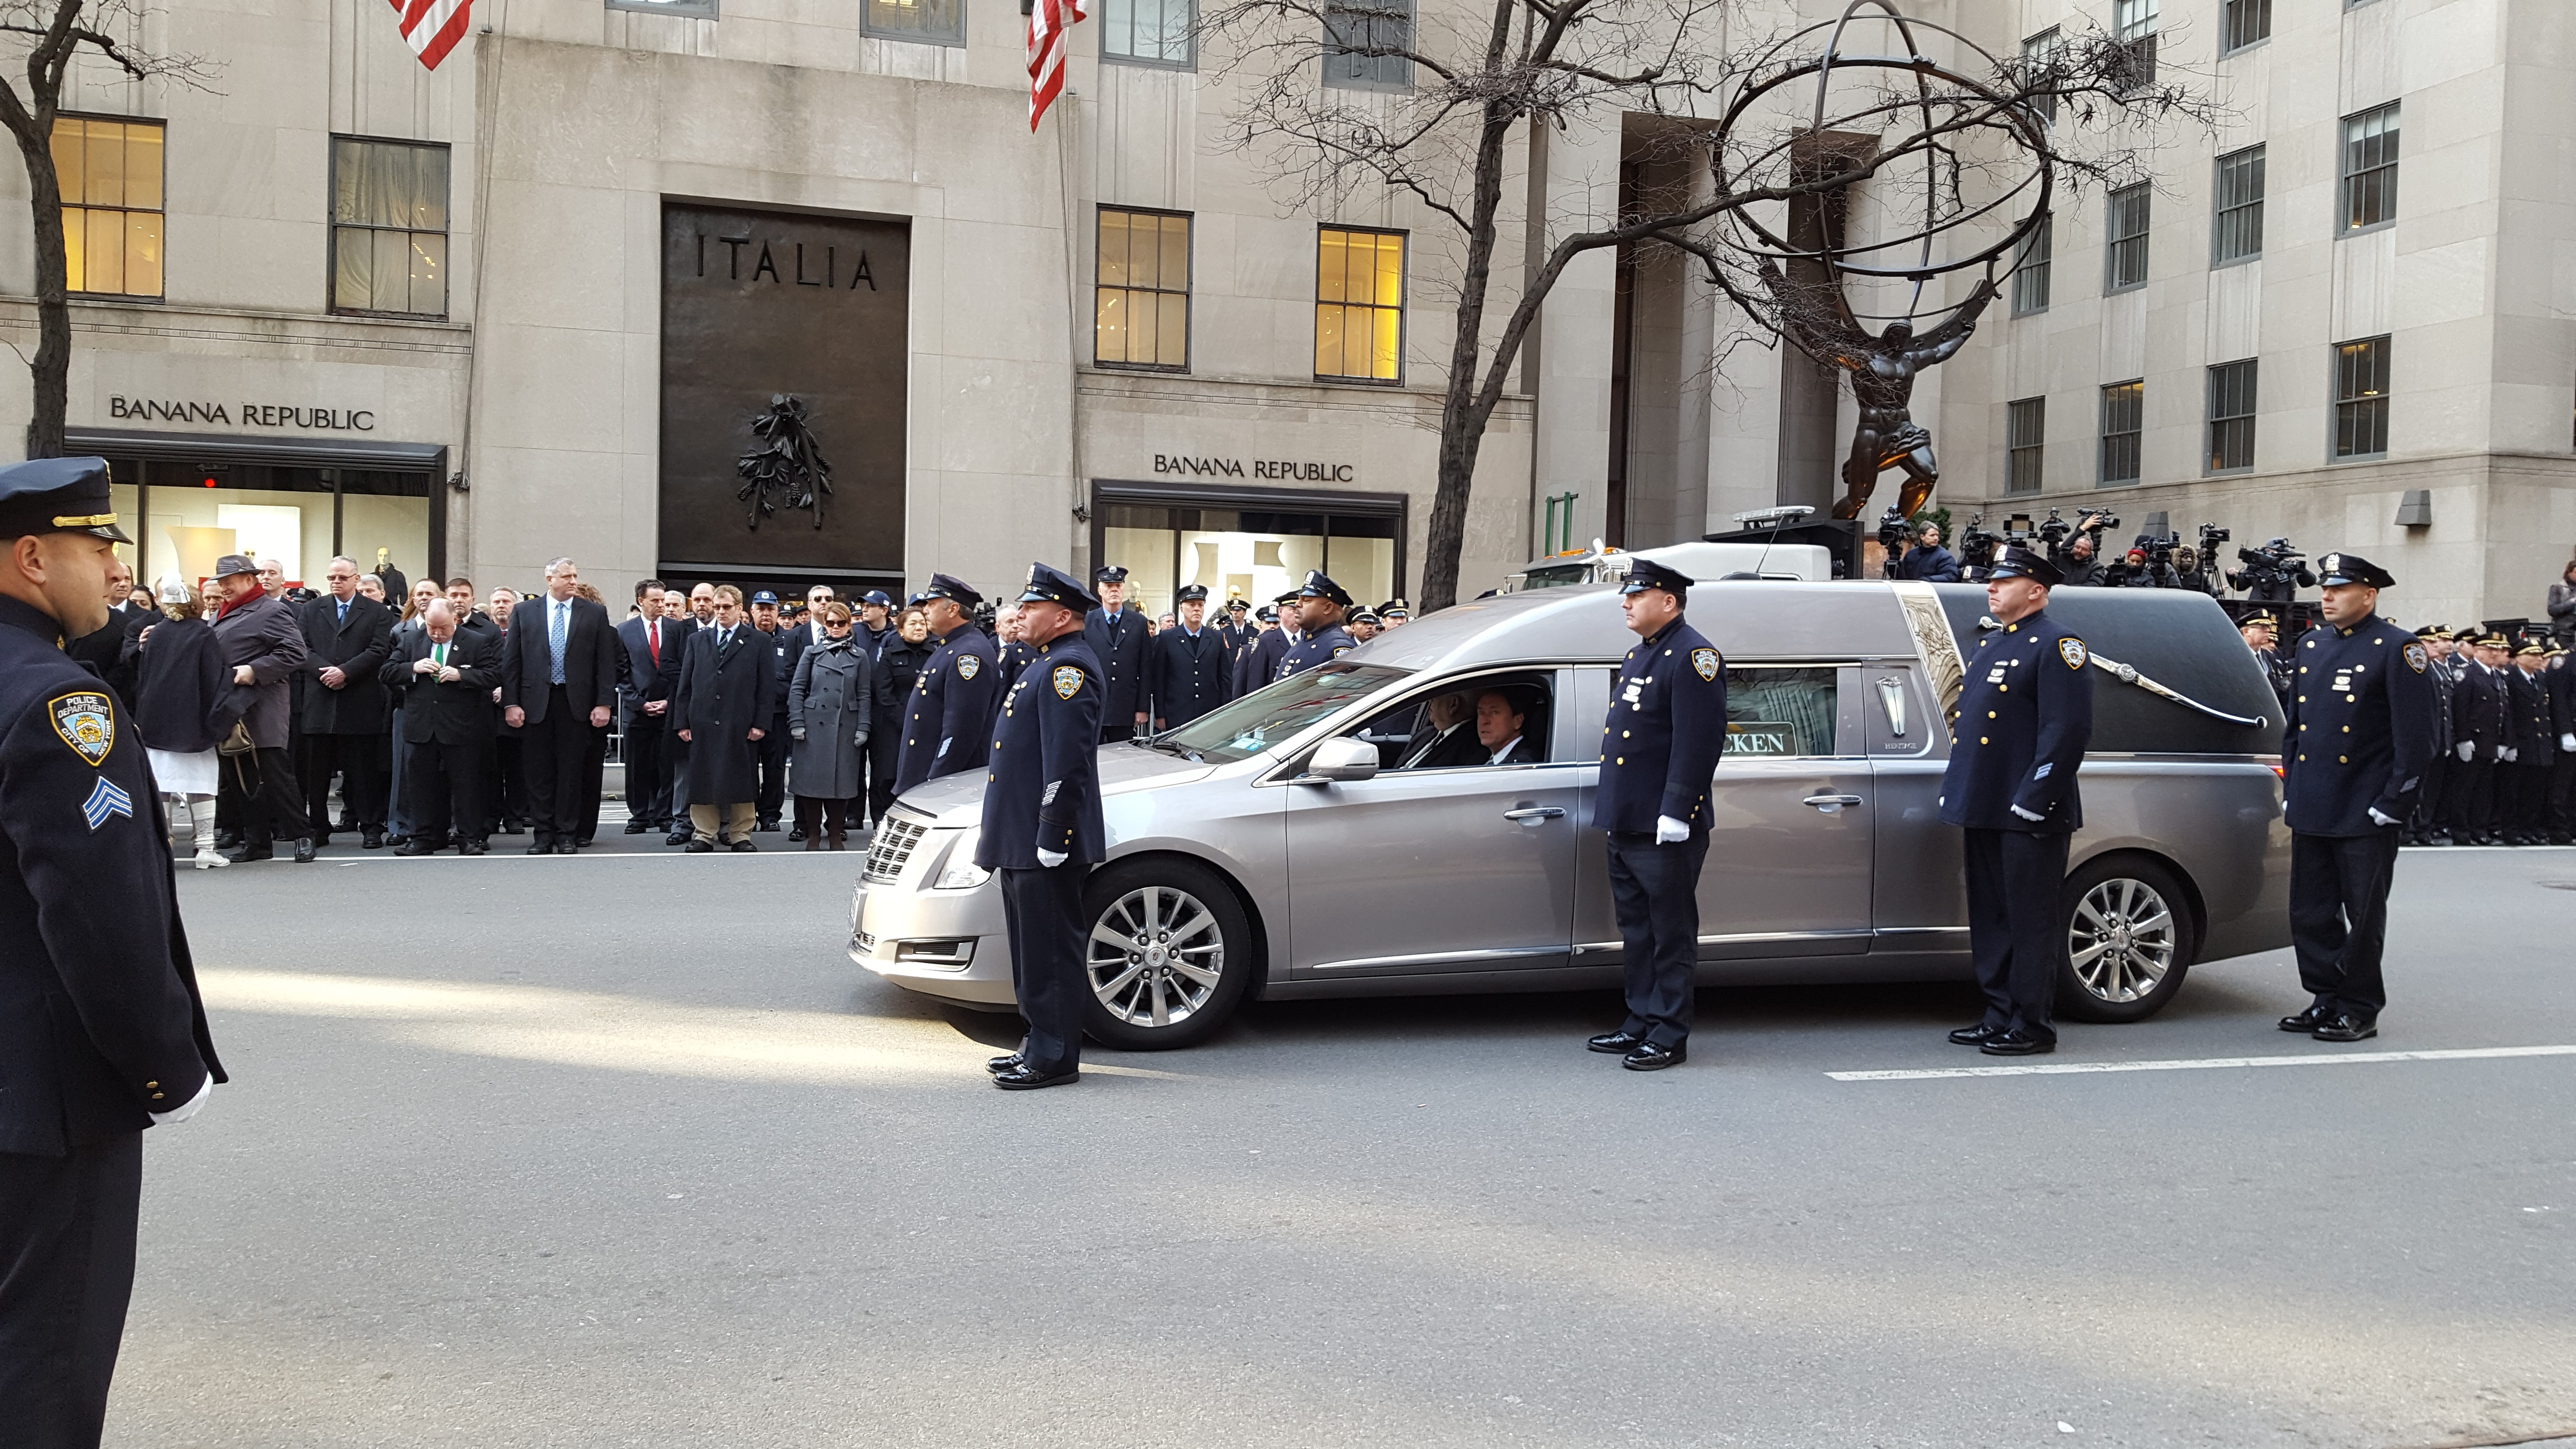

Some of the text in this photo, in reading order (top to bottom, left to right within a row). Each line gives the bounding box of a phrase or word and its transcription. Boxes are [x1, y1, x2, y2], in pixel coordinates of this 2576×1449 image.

[697, 234, 877, 291] ITALIA
[110, 397, 374, 431] BANANA REPUBLIC
[1154, 454, 1353, 482] BANANA REPUBLIC
[58, 704, 108, 719] DEPARTMENT
[66, 696, 98, 707] POLICE
[61, 727, 90, 754] CITY OF
[98, 741, 109, 756] NEW
